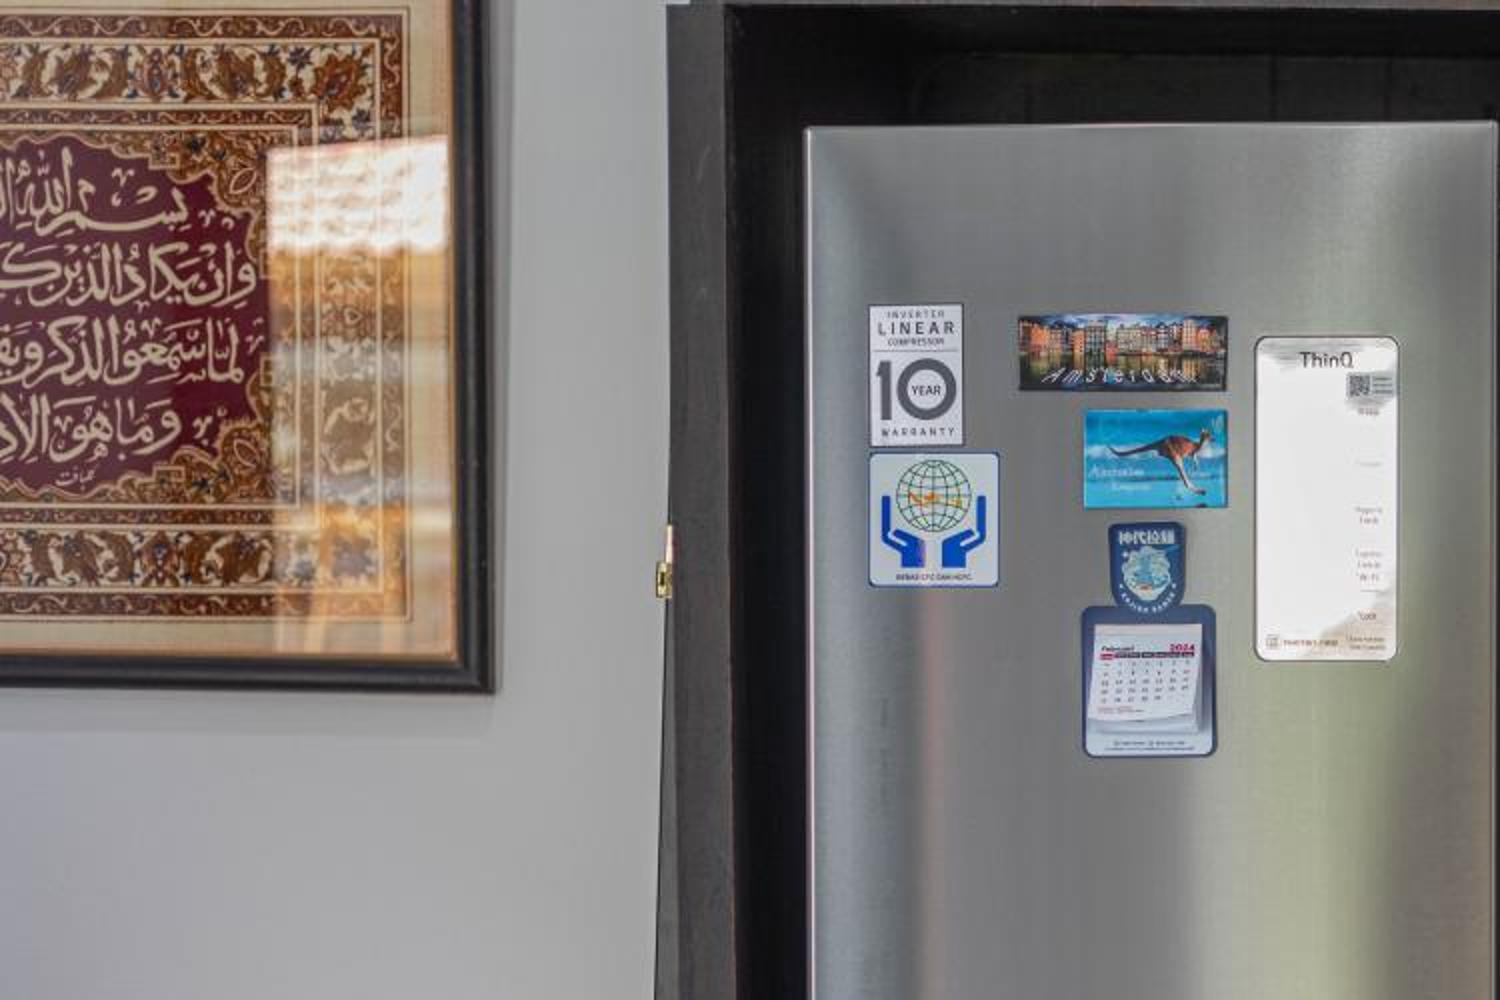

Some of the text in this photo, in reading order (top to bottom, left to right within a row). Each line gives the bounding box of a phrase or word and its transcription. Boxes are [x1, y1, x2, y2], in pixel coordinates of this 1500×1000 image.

[886, 308, 945, 319] INVERTER
[877, 321, 955, 336] LINEAR
[887, 337, 945, 347] COMPRESSOR
[1299, 351, 1354, 370] ThinQ
[1040, 366, 1198, 385] Amsterdam
[876, 357, 957, 421] 10
[911, 384, 942, 397] YEAR
[880, 426, 955, 438] WARRANTY
